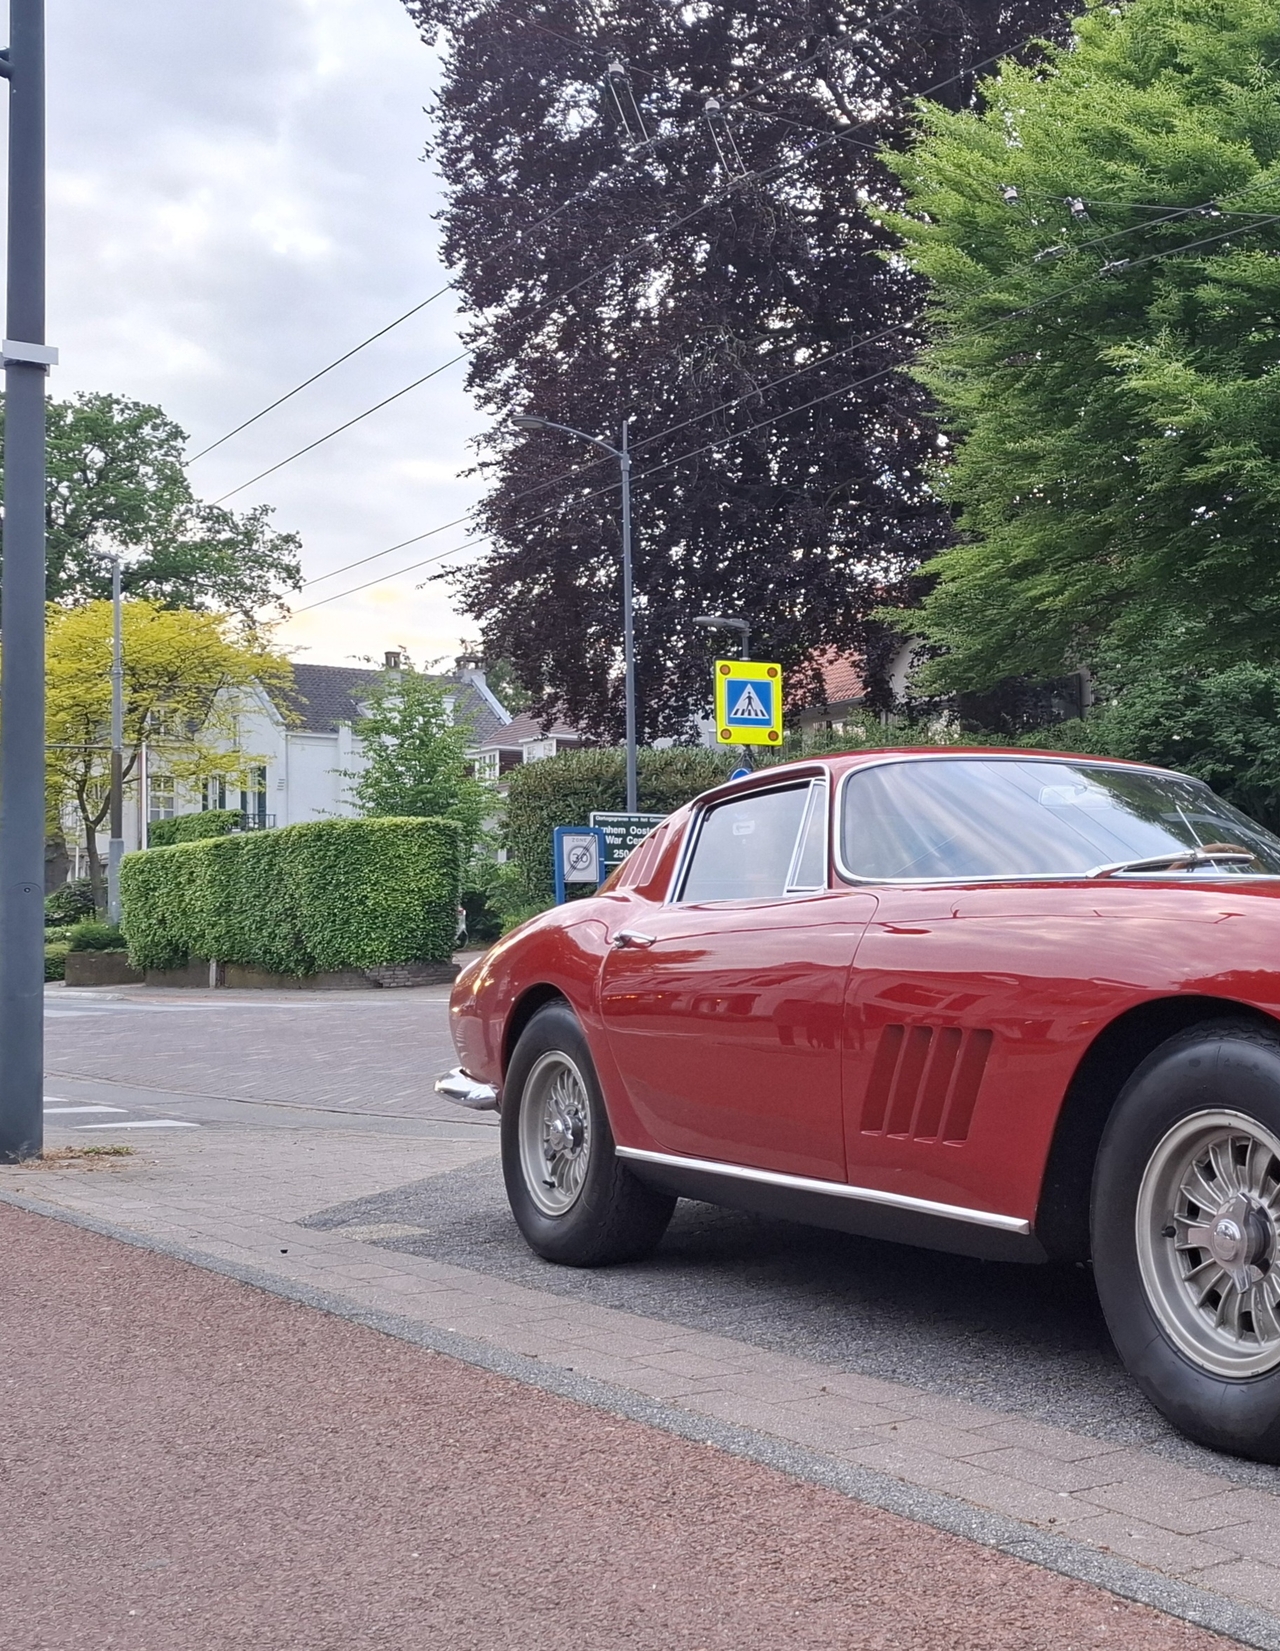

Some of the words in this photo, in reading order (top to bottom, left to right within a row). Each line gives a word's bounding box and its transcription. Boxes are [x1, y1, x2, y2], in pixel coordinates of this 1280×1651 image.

[605, 835, 623, 845] War
[572, 853, 588, 863] 30
[613, 849, 629, 859] 250
